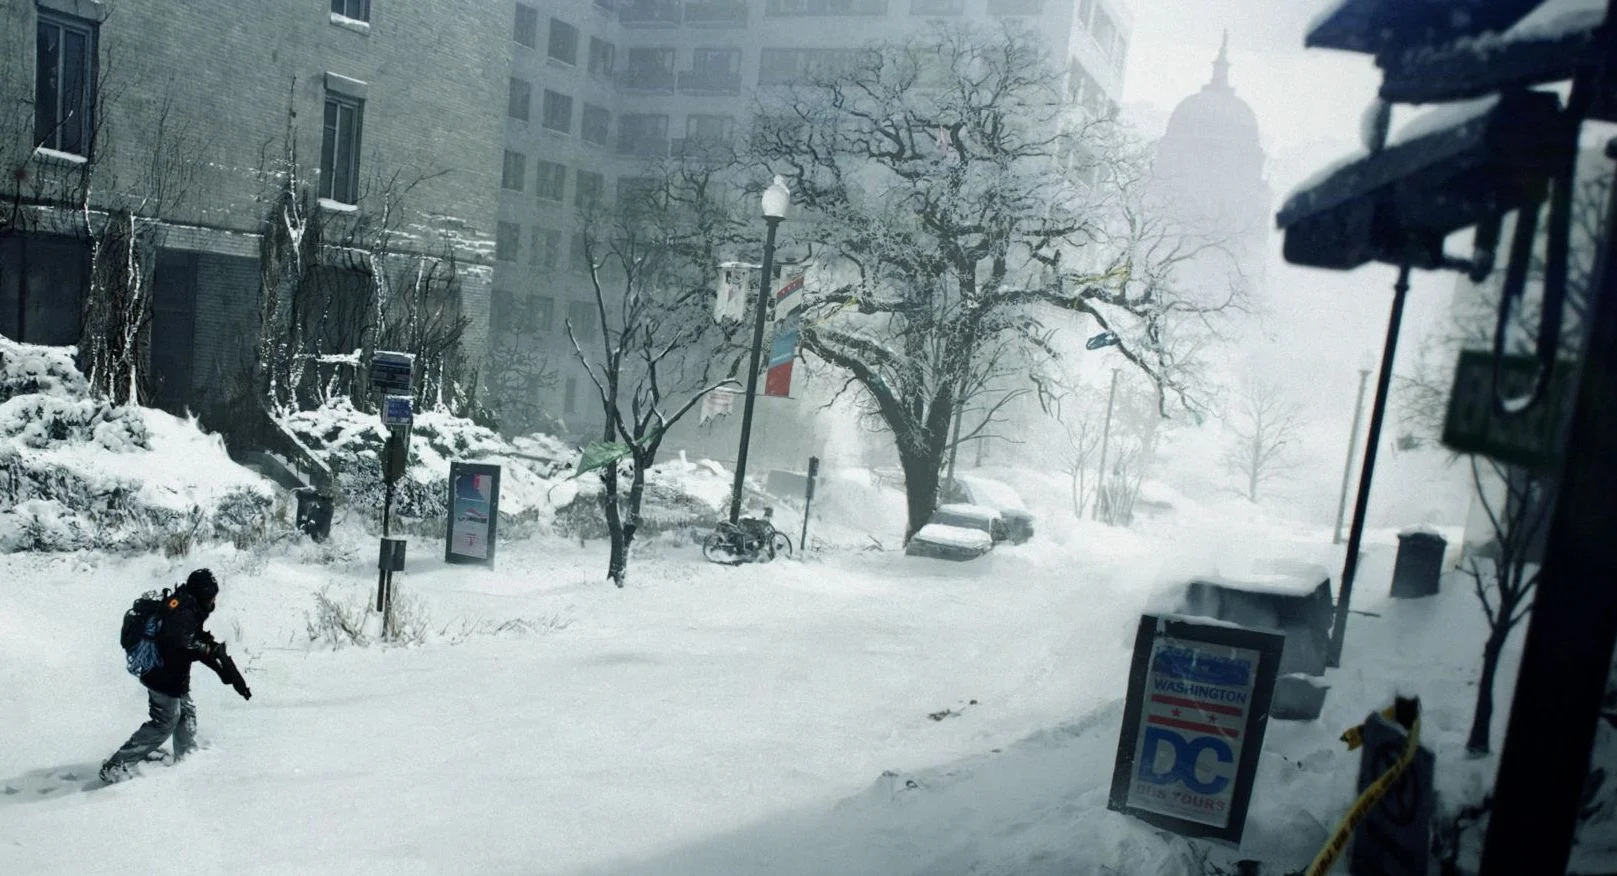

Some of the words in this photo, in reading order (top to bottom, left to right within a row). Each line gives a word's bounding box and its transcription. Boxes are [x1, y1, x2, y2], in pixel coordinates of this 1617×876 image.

[1154, 679, 1247, 703] WASHINGTON
[1139, 726, 1233, 795] DC
[1172, 790, 1225, 811] TOURS
